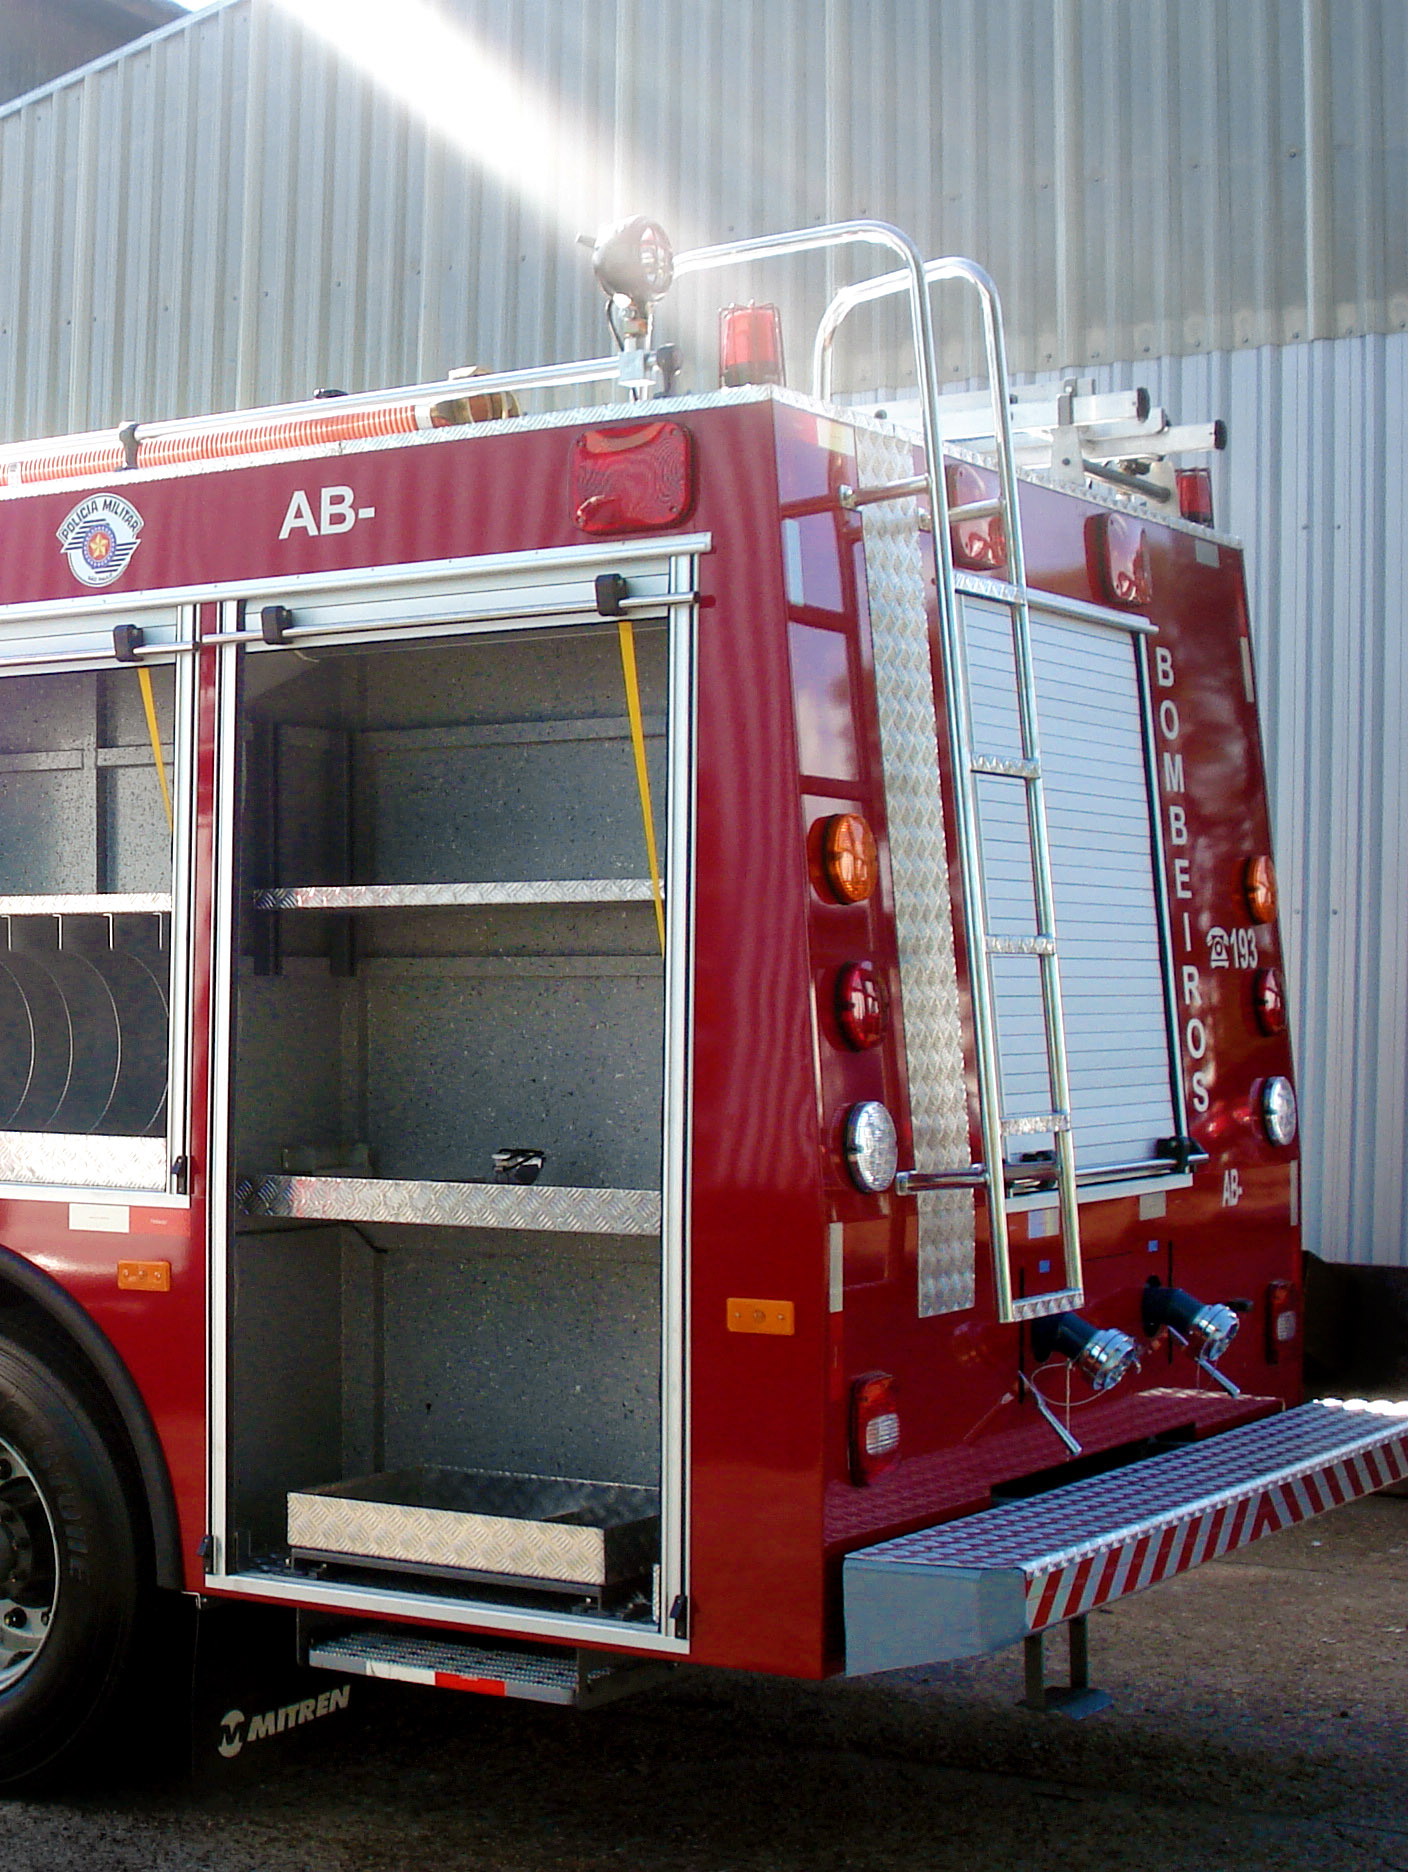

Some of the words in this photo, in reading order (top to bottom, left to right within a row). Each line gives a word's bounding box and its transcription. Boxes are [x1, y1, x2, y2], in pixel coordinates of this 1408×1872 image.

[102, 498, 139, 533] MILITAR
[278, 485, 376, 540] AB-
[1155, 646, 1211, 1113] BOMBEIROS
[1230, 928, 1259, 969] 193
[247, 1684, 351, 1742] MITREN
